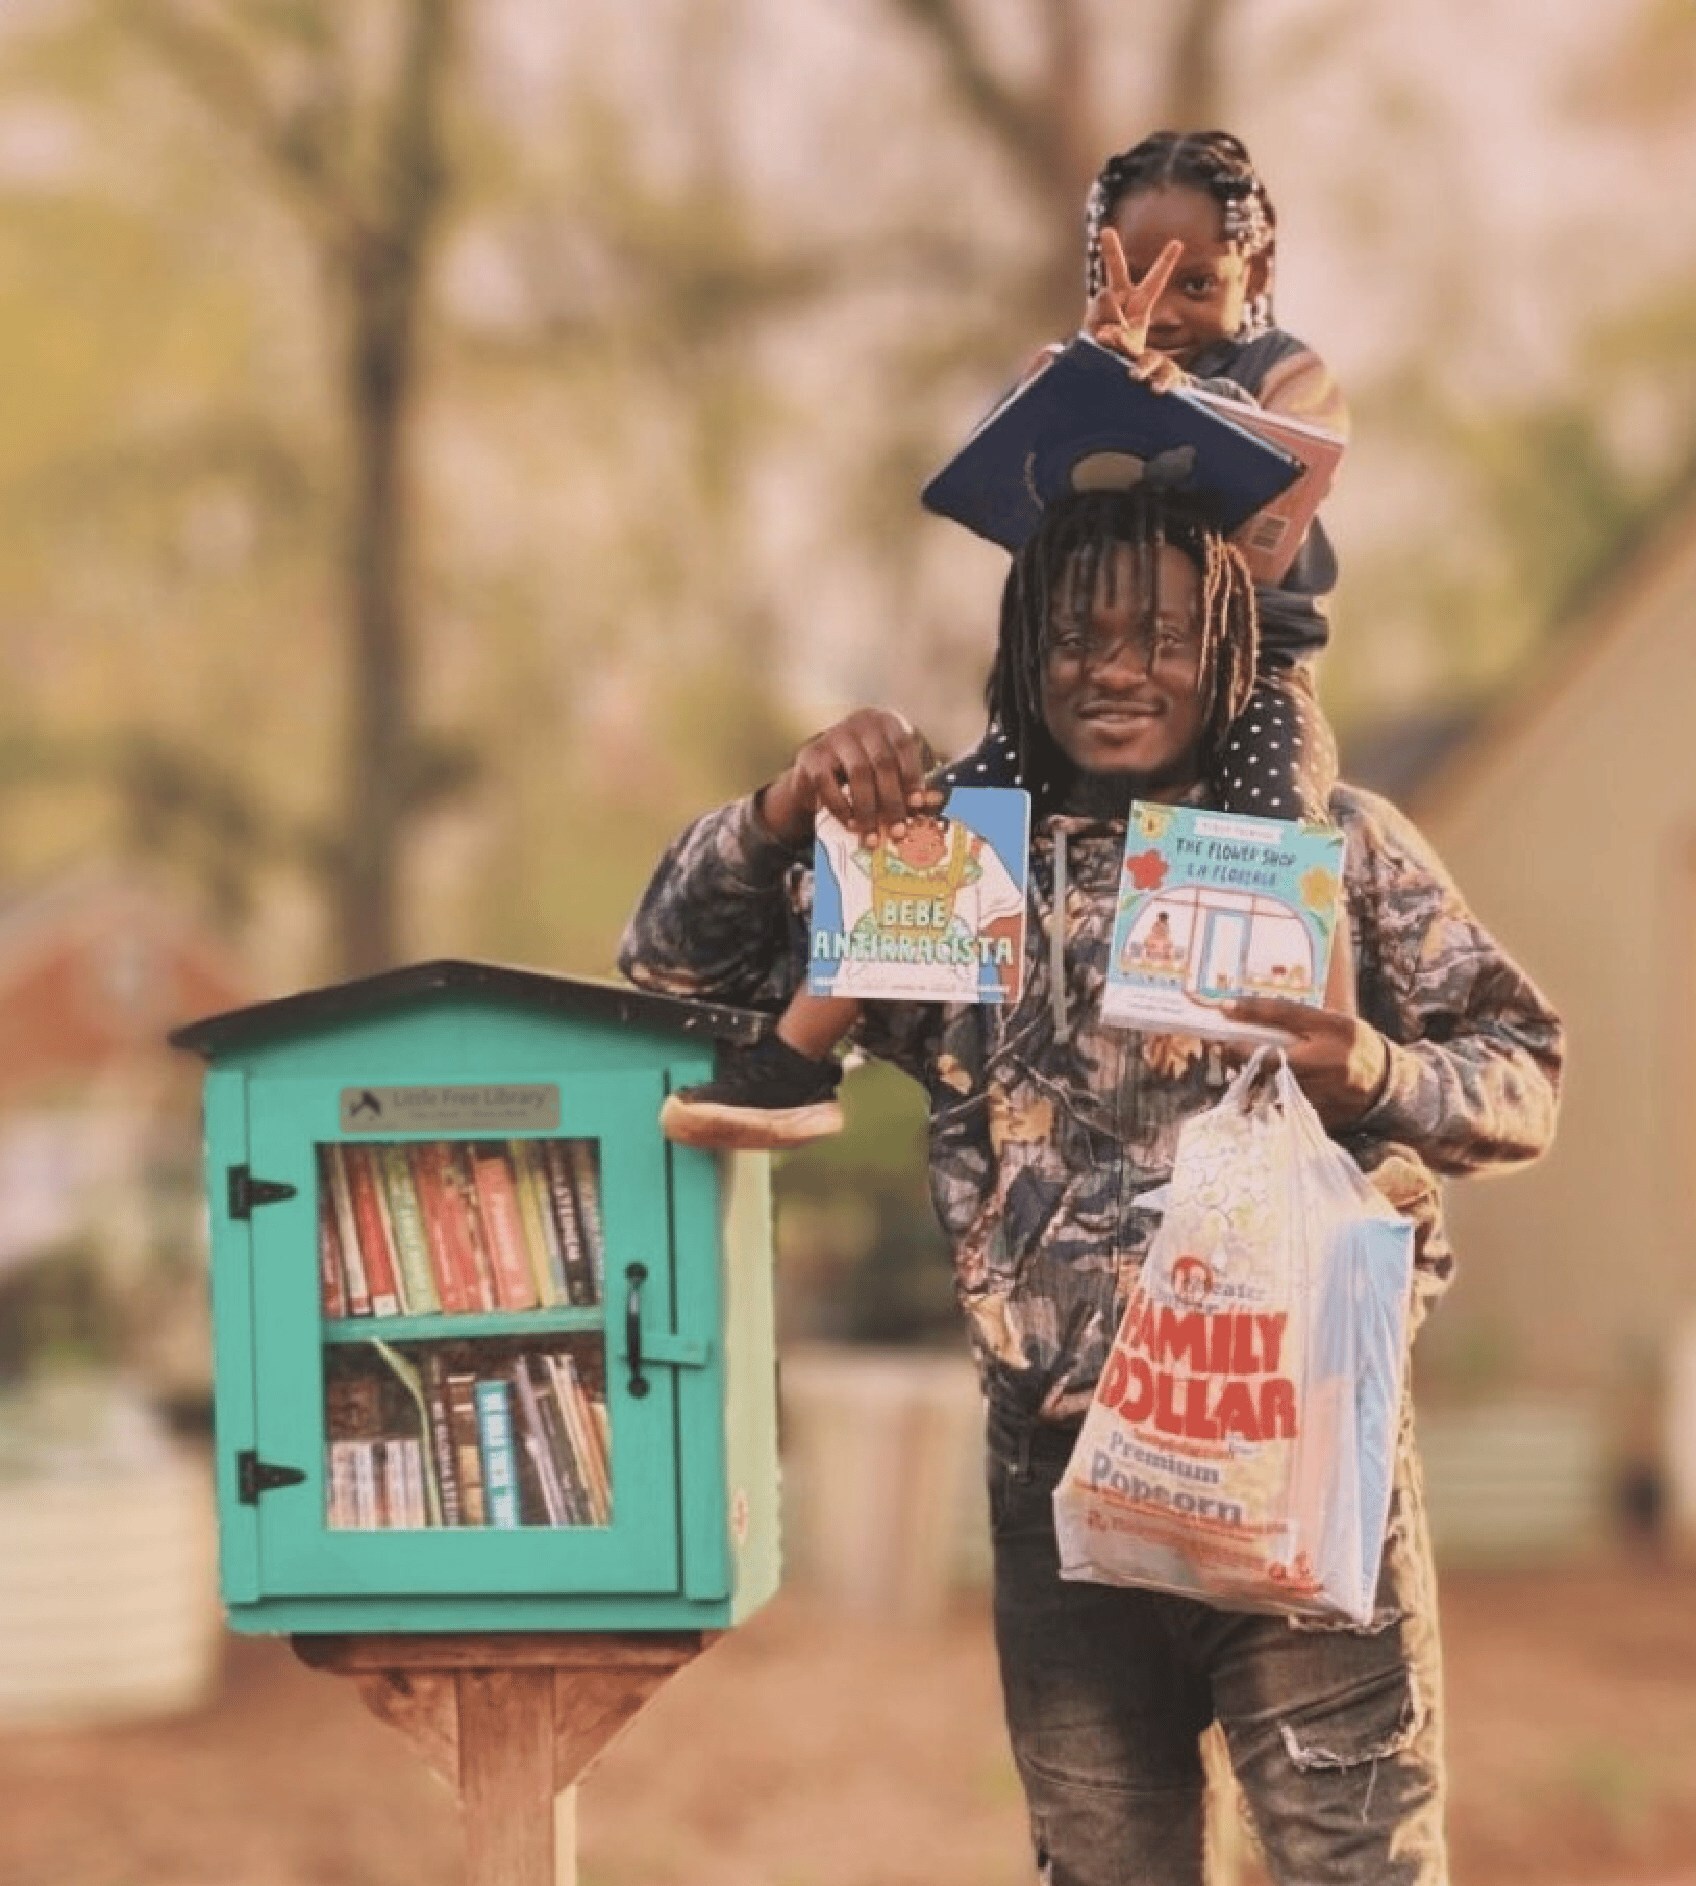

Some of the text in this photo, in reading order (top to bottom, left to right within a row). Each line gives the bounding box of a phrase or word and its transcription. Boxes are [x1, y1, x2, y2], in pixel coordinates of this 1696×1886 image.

[813, 930, 1013, 967] ANTIRRACISTA
[393, 1086, 546, 1110] Little Free Library
[1110, 1431, 1220, 1484] Premium
